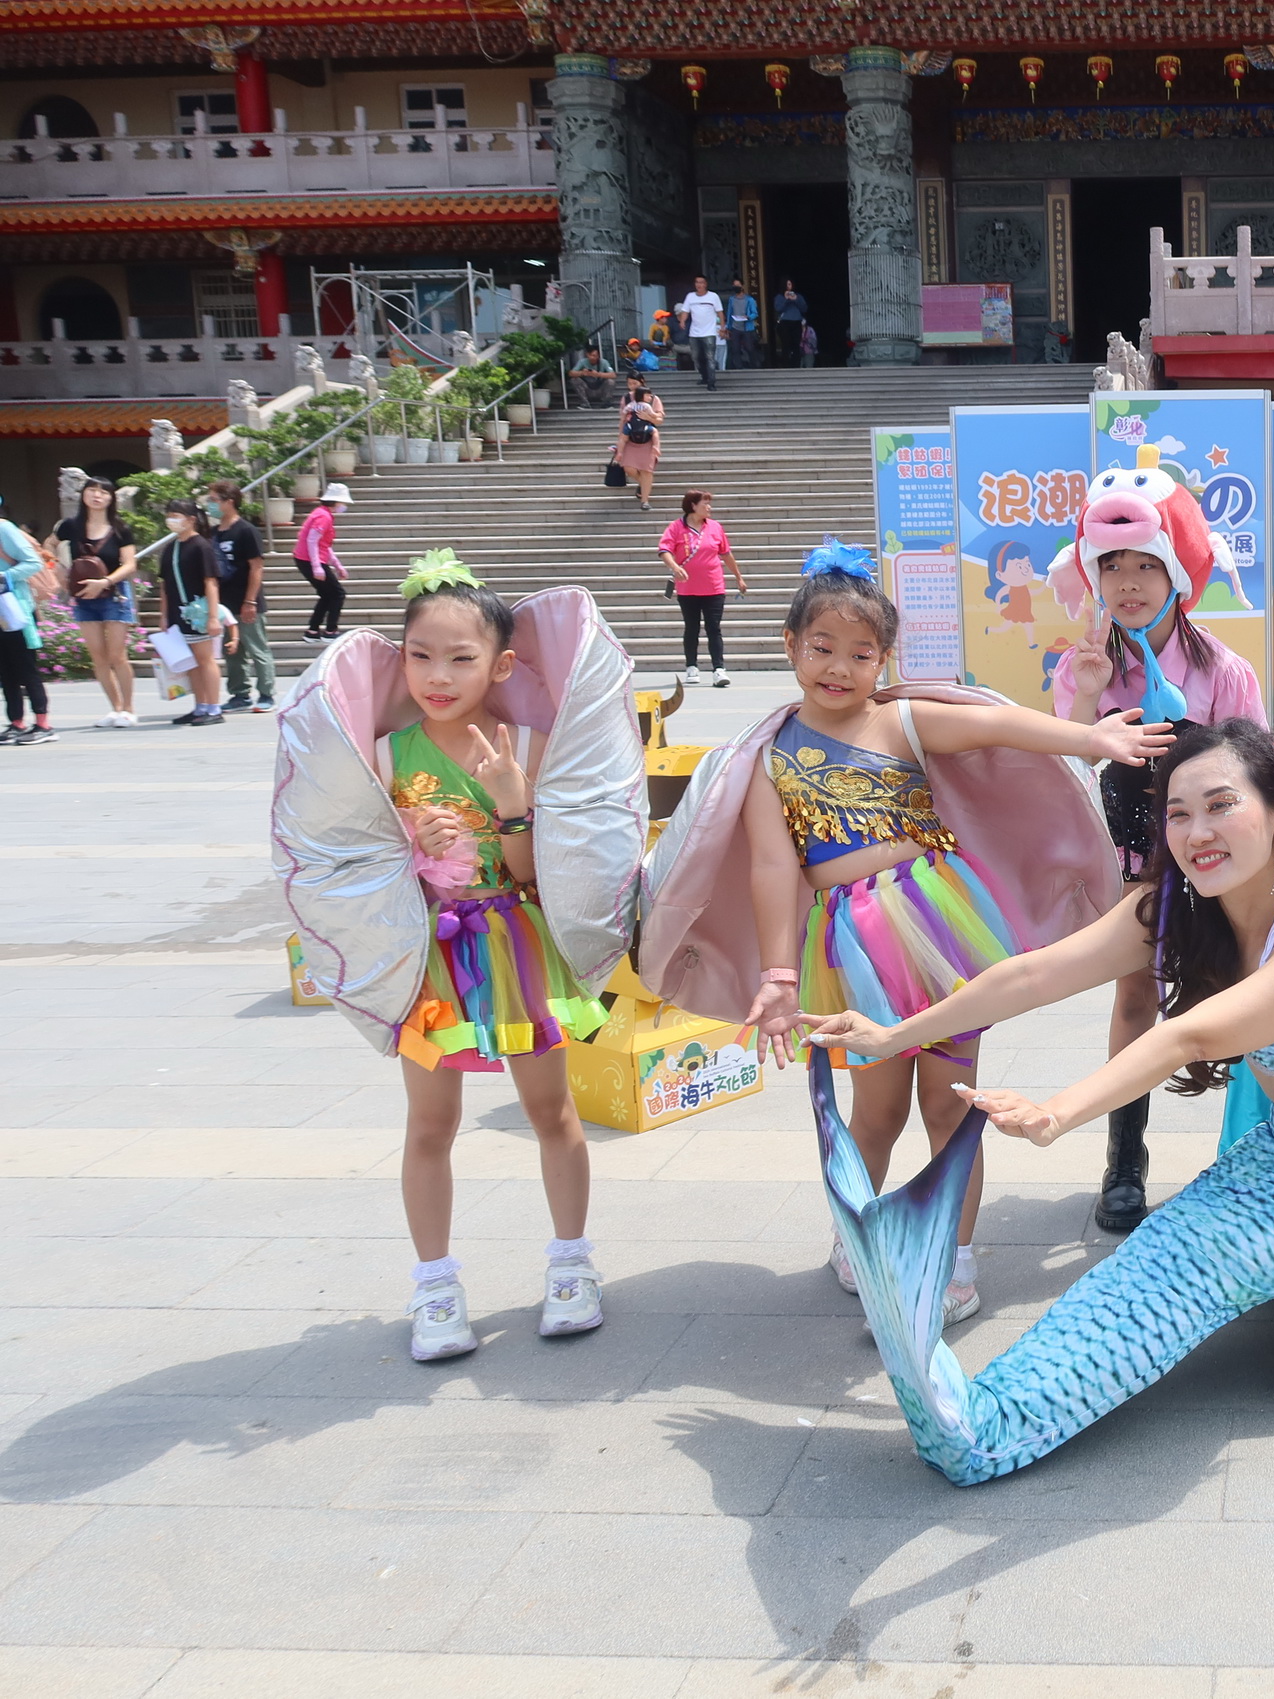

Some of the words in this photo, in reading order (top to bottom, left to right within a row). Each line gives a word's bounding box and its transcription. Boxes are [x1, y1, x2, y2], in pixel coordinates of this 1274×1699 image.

[980, 470, 1089, 525] 浪潮
[1200, 475, 1254, 527] の
[646, 1064, 757, 1115] 國際海牛文化節
